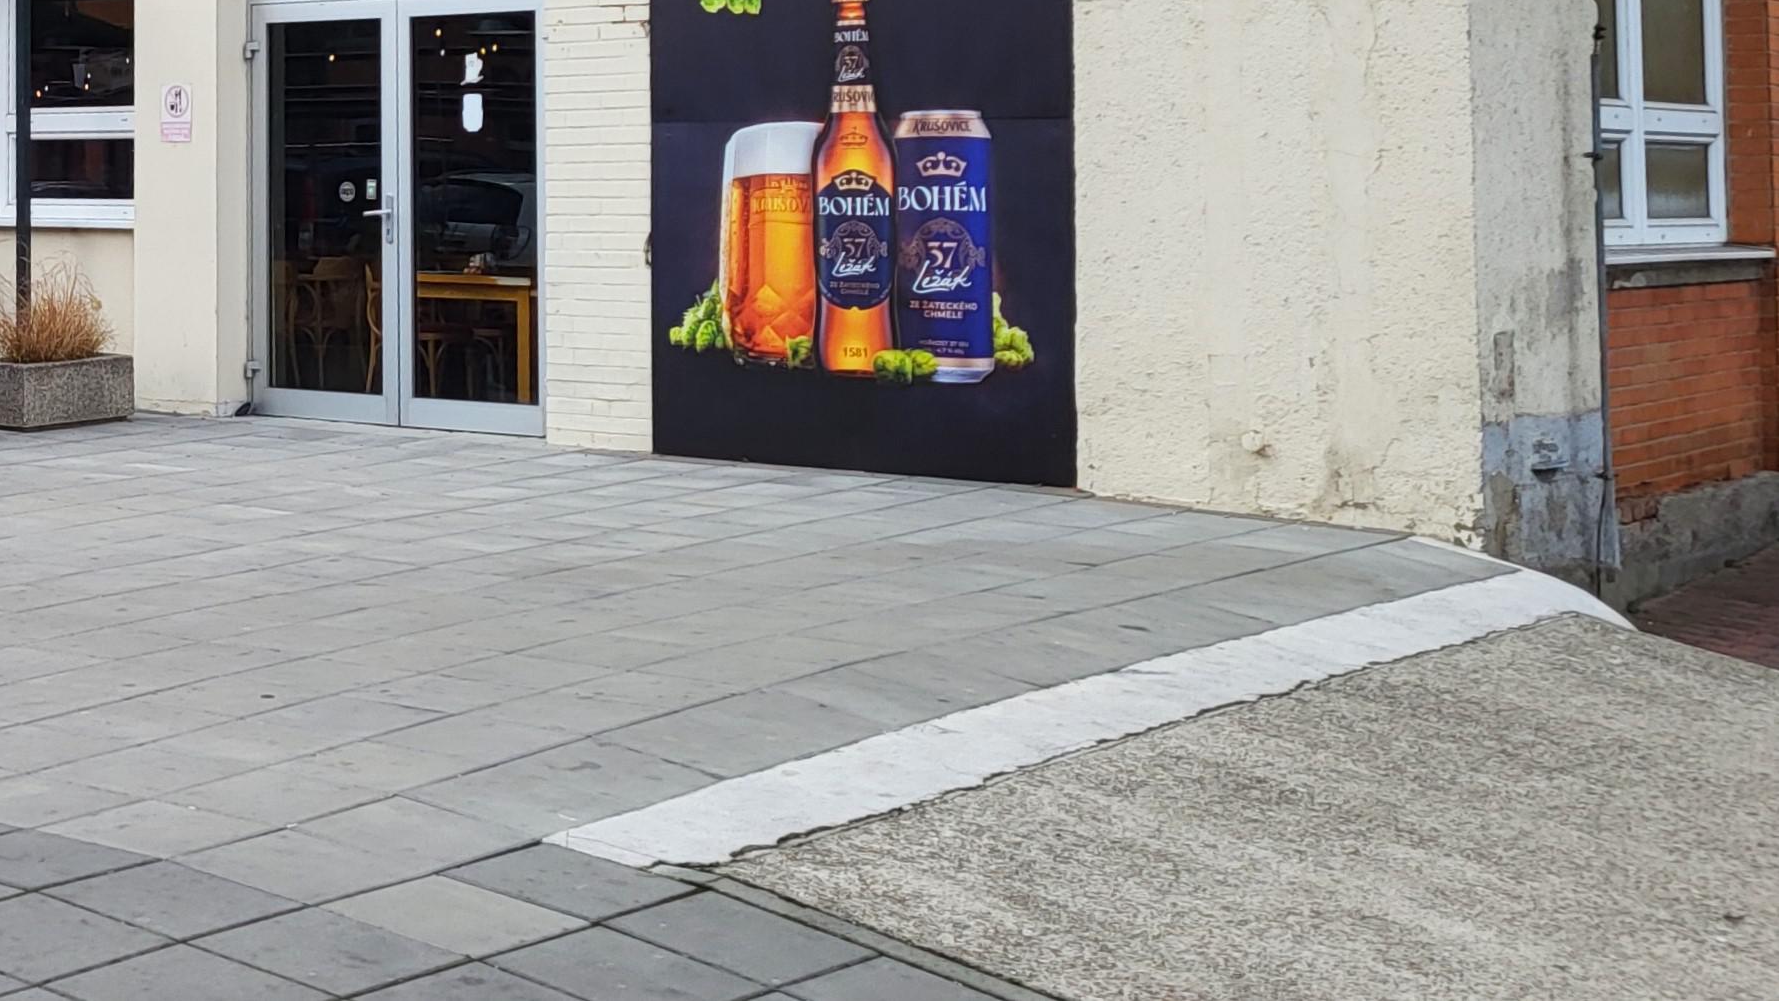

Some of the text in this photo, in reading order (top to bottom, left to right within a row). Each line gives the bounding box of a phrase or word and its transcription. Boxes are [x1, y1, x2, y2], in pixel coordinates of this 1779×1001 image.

[818, 193, 890, 217] BOHÉM
[897, 180, 987, 213] BOHÉM
[831, 251, 877, 277] Ležák
[926, 241, 959, 270] 37
[912, 259, 972, 294] Ležák
[842, 346, 869, 359] 1581
